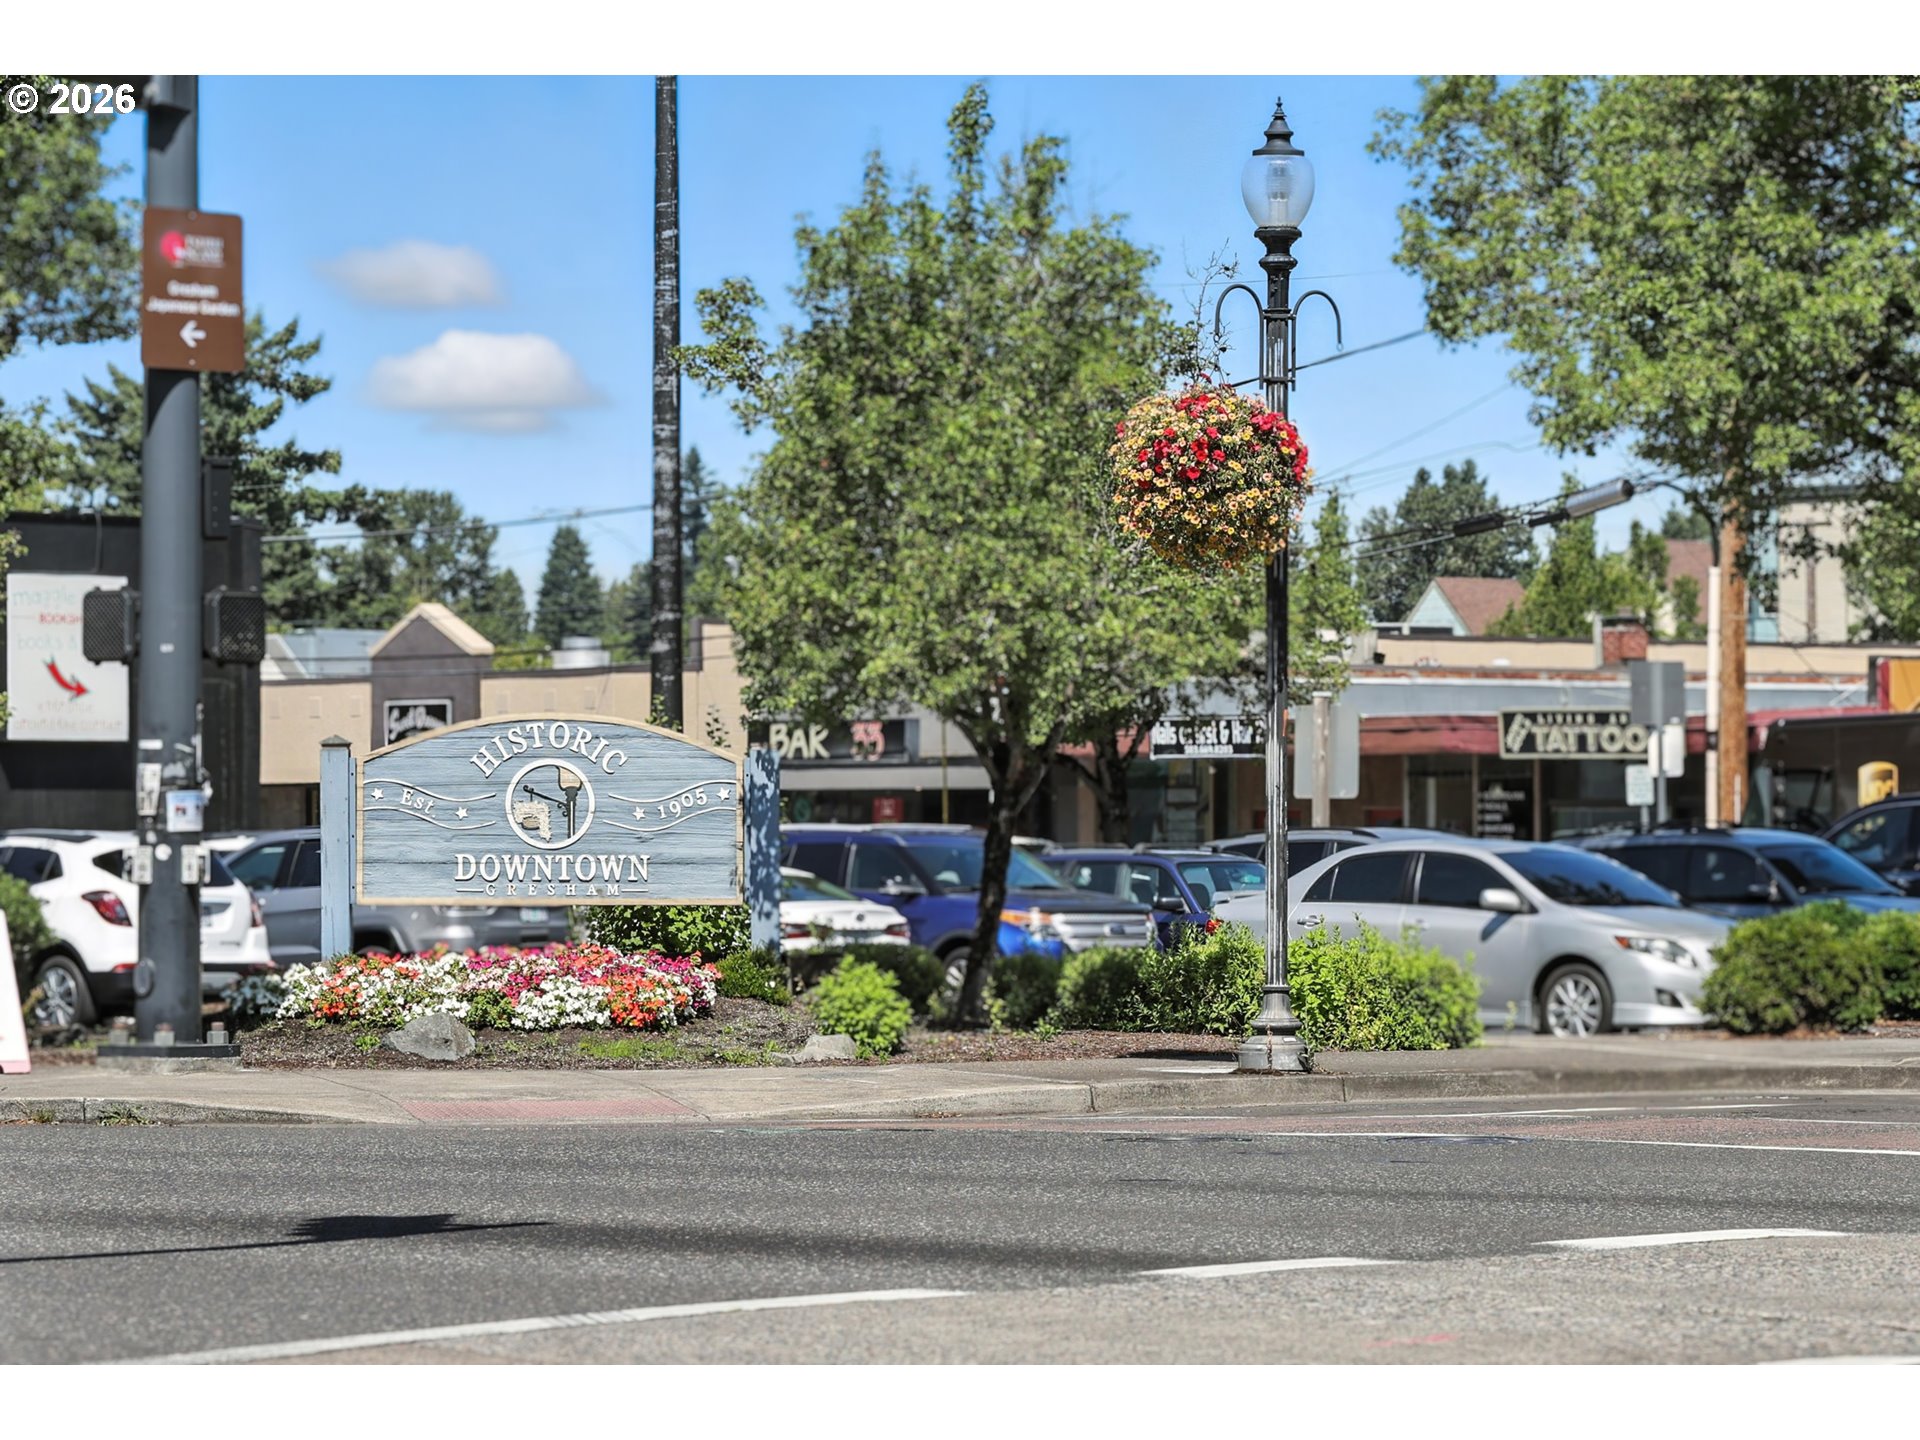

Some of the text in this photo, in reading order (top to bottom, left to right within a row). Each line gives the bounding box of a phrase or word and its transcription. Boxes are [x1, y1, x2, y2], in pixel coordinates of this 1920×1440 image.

[470, 721, 629, 778] HISTORIC
[769, 722, 831, 759] BAR
[1531, 724, 1649, 754] TATTOO
[402, 789, 437, 818] Est.
[657, 789, 708, 820] 1905
[454, 853, 651, 883] DOWNTOWN
[485, 884, 620, 896] GRESHAM
